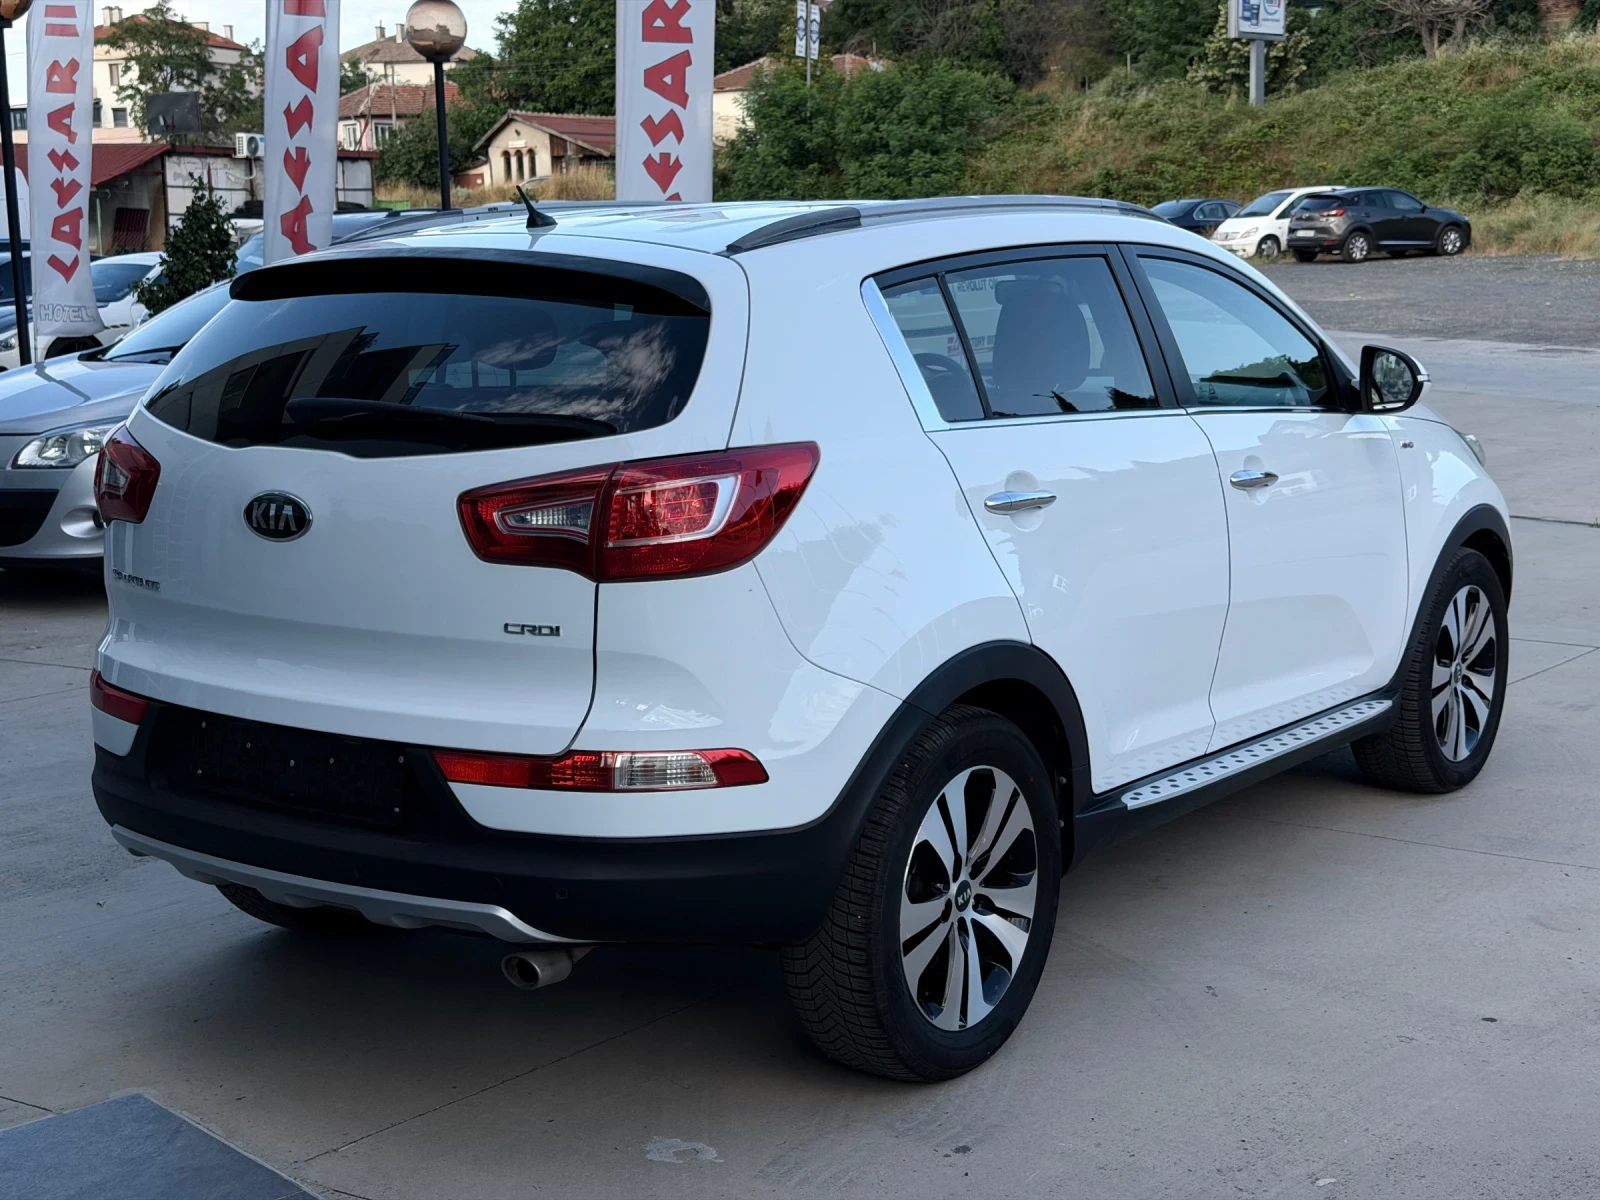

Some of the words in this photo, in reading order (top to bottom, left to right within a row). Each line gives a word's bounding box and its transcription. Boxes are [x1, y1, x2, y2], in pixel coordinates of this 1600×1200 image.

[280, 0, 326, 255] AESA
[640, 0, 694, 201] ESAR
[46, 57, 84, 284] CAESAR
[39, 303, 95, 323] HOTEL
[252, 501, 298, 531] KIA
[957, 888, 971, 906] KIA
